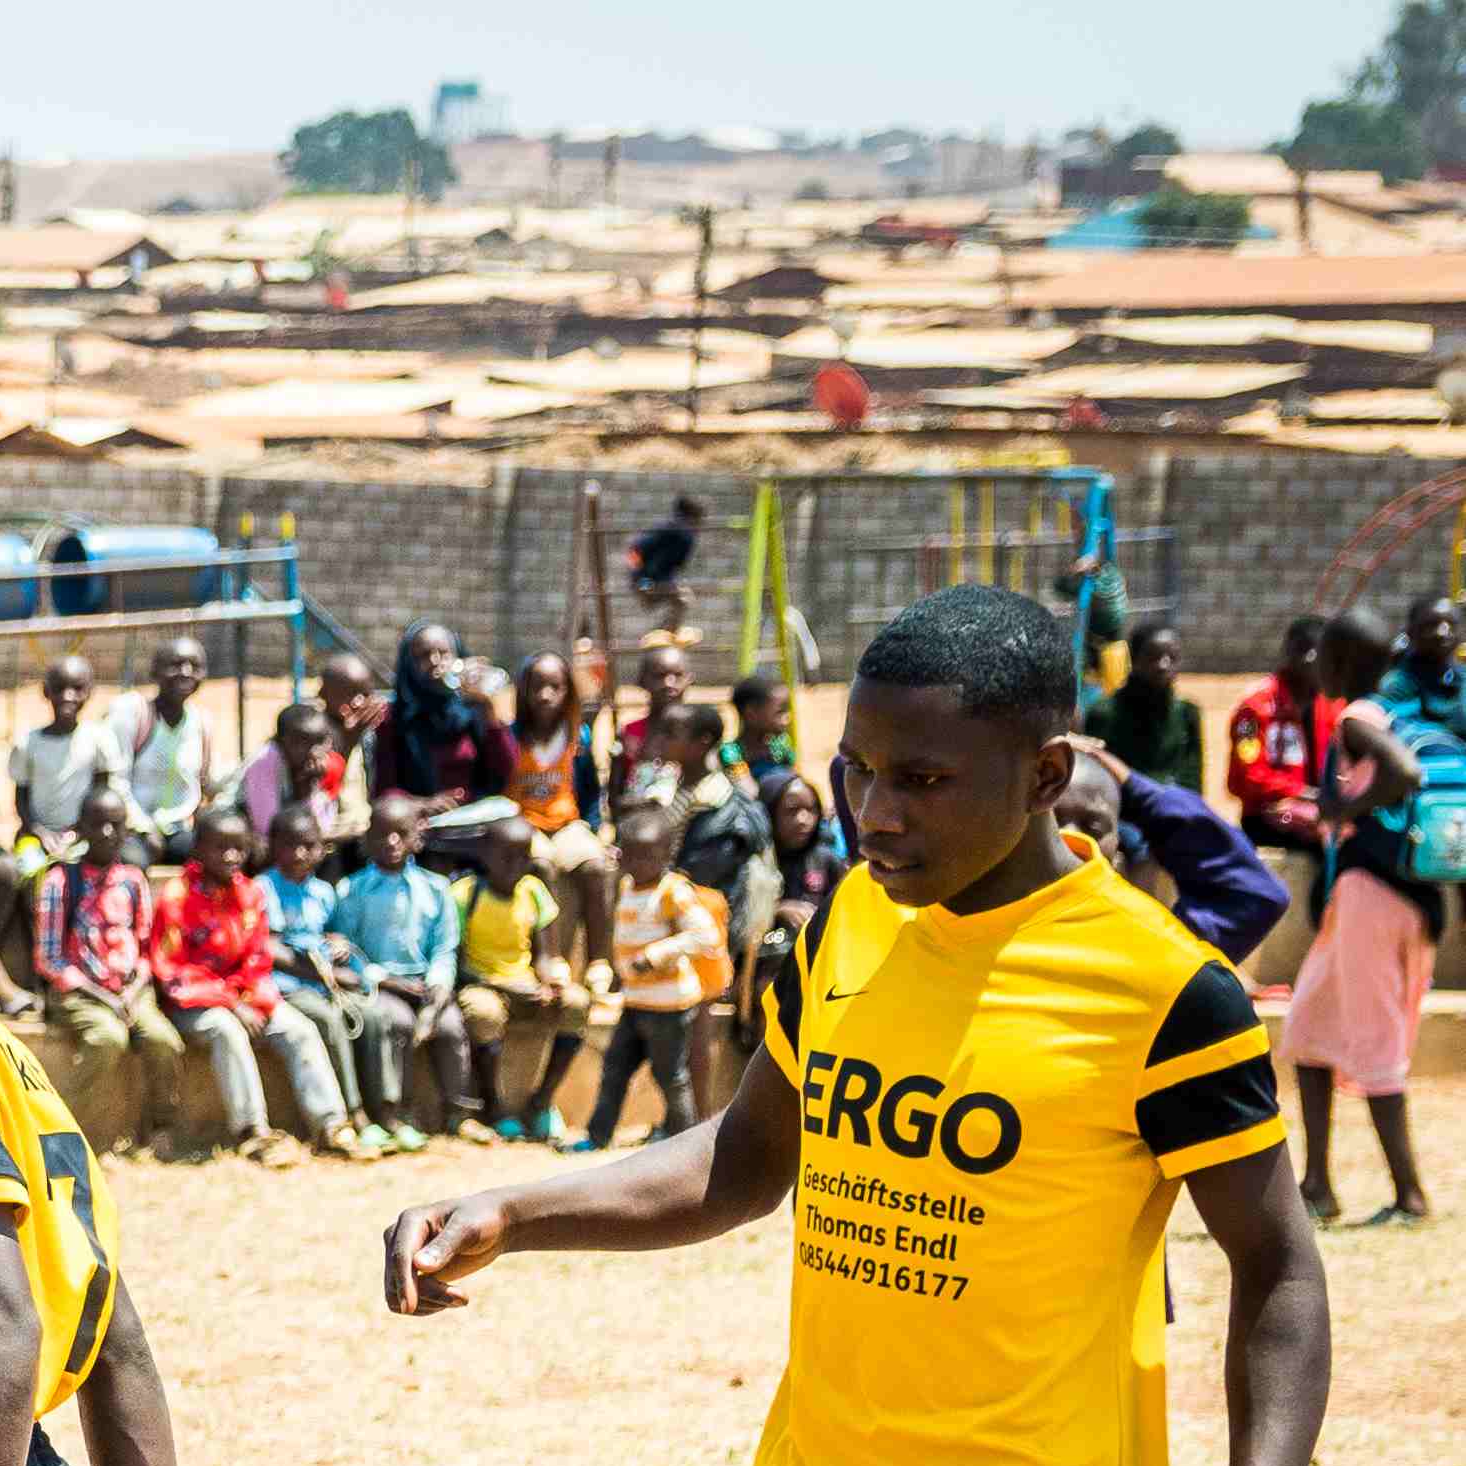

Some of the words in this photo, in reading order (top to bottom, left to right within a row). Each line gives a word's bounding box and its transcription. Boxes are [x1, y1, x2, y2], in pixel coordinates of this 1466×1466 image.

[803, 1050, 1022, 1175] ERGO
[803, 1163, 986, 1226] Geschäftsstelle
[806, 1204, 887, 1247] Thomas
[895, 1225, 958, 1262] Endl
[800, 1241, 969, 1301] 08544/916177
